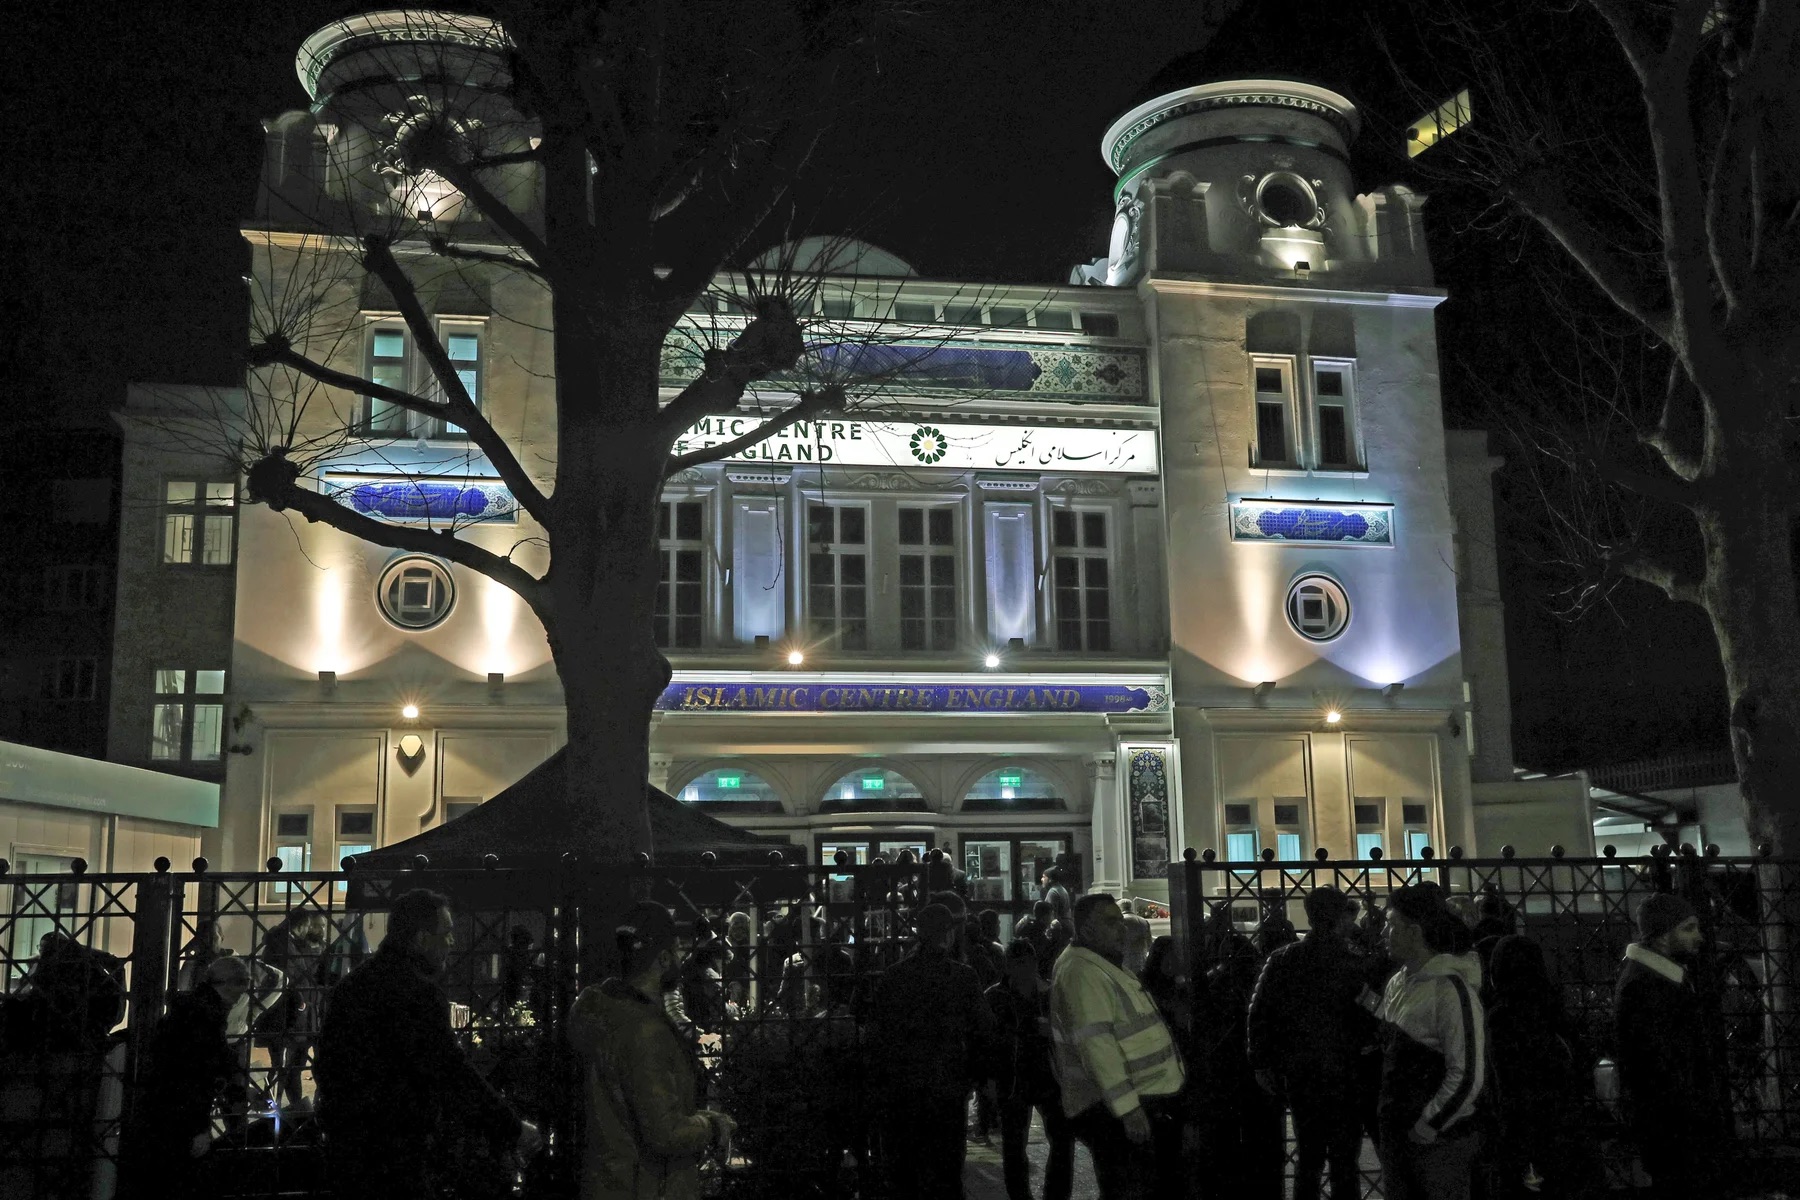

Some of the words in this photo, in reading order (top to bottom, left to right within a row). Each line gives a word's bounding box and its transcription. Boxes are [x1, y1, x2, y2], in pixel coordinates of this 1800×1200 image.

[684, 418, 744, 436] MIC
[759, 420, 862, 440] ENTRE
[704, 441, 833, 461] GLAND
[683, 686, 809, 708] ISLAMIC
[820, 688, 934, 709] CENTRE
[945, 689, 1081, 709] ENGLAND
